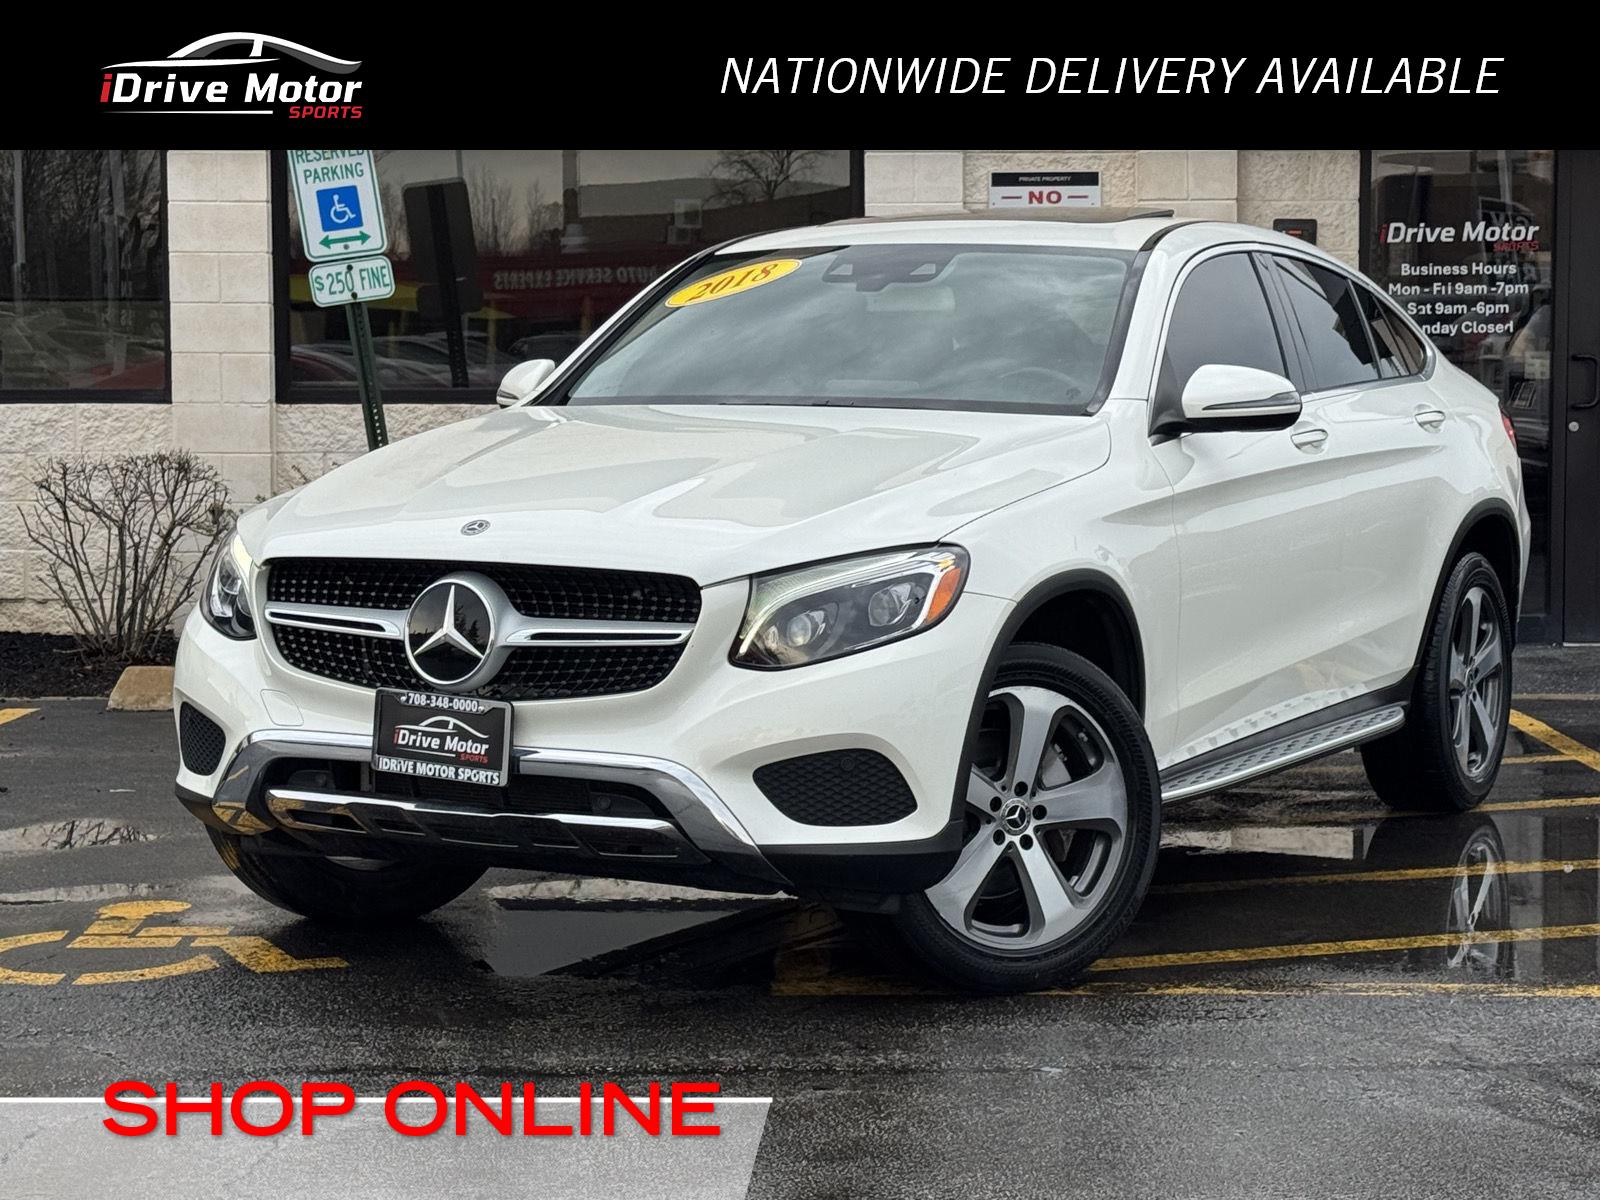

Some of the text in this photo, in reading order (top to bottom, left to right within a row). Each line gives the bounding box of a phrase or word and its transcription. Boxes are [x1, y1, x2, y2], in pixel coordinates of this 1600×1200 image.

[303, 162, 364, 184] PARKING
[1028, 190, 1062, 205] NO
[1379, 221, 1540, 245] iDrive Motor
[1401, 262, 1468, 276] Business
[1472, 262, 1517, 275] Hours
[314, 265, 390, 296] $250 FINE
[687, 263, 778, 302] 2018
[1388, 283, 1420, 295] Mon
[1455, 282, 1487, 295] 9am
[1407, 302, 1432, 315] Sat
[1435, 302, 1467, 314] 9am
[1421, 321, 1514, 336] nday Closed
[408, 692, 478, 712] 708-348-0000
[393, 728, 489, 755] iDrive Motor
[460, 752, 489, 764] SPORTS
[416, 762, 456, 779] MOTOR
[457, 767, 500, 785] SPORTS
